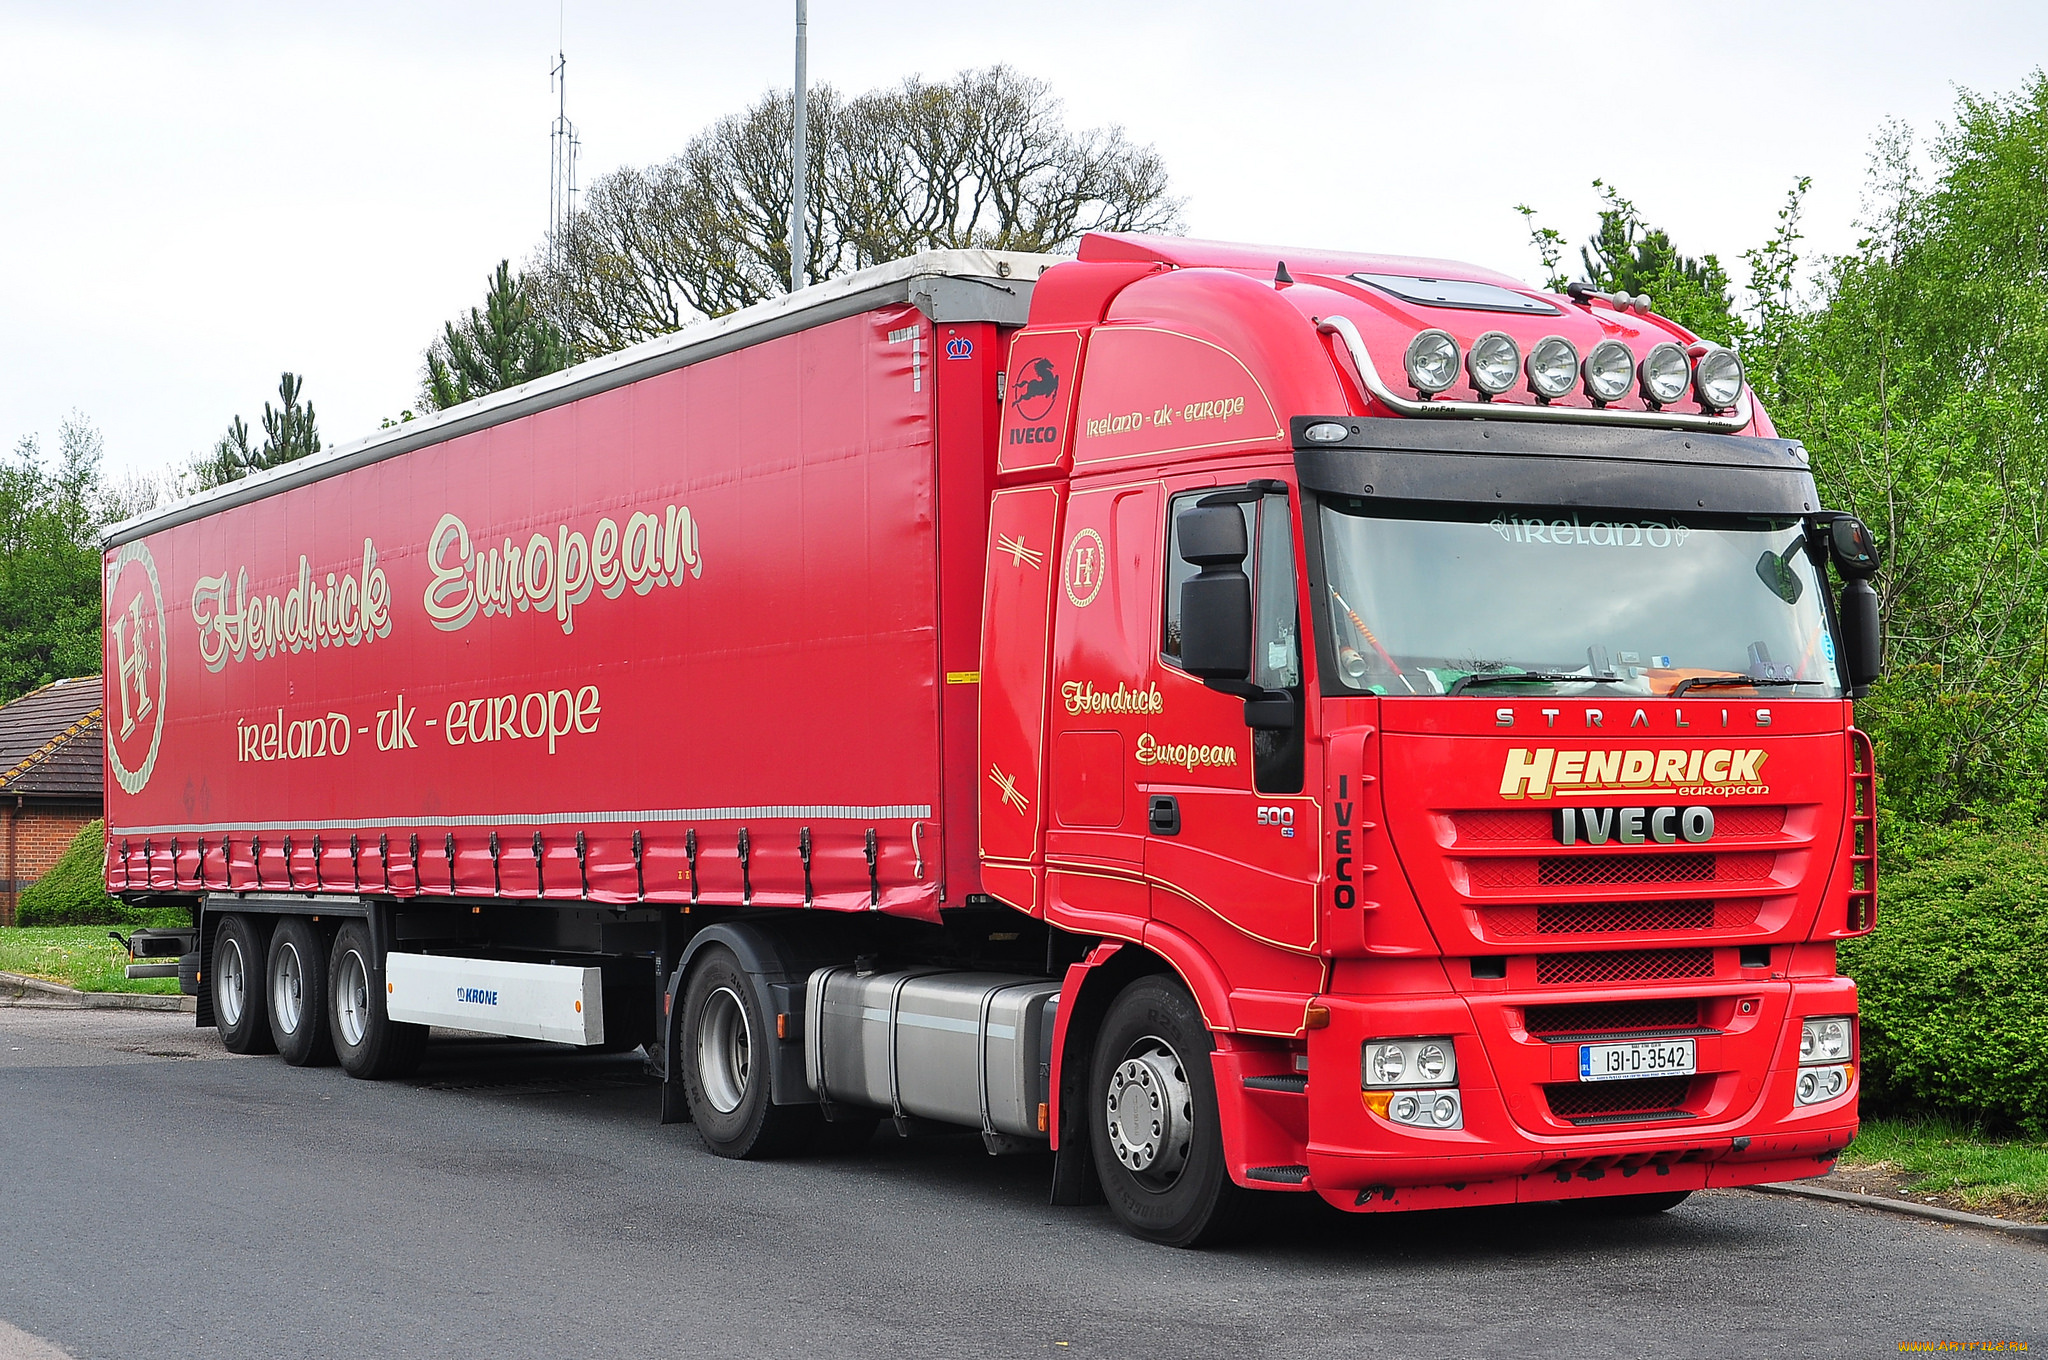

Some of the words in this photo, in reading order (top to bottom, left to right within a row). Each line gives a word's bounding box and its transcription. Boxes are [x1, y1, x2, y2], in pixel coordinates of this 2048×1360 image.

[1009, 426, 1057, 445] IVECO
[192, 537, 392, 673] Hendrick
[423, 504, 703, 635] European
[1061, 680, 1164, 715] Hendrick
[1495, 707, 1773, 728] STRALIS
[1135, 732, 1238, 773] European
[1498, 747, 1770, 801] HENDRICK
[1257, 806, 1294, 826] 500
[1560, 805, 1716, 846] IVECO
[1334, 775, 1355, 910] IVECO
[465, 988, 498, 1006] KRONE
[1606, 1047, 1685, 1072] 131-D-3542
